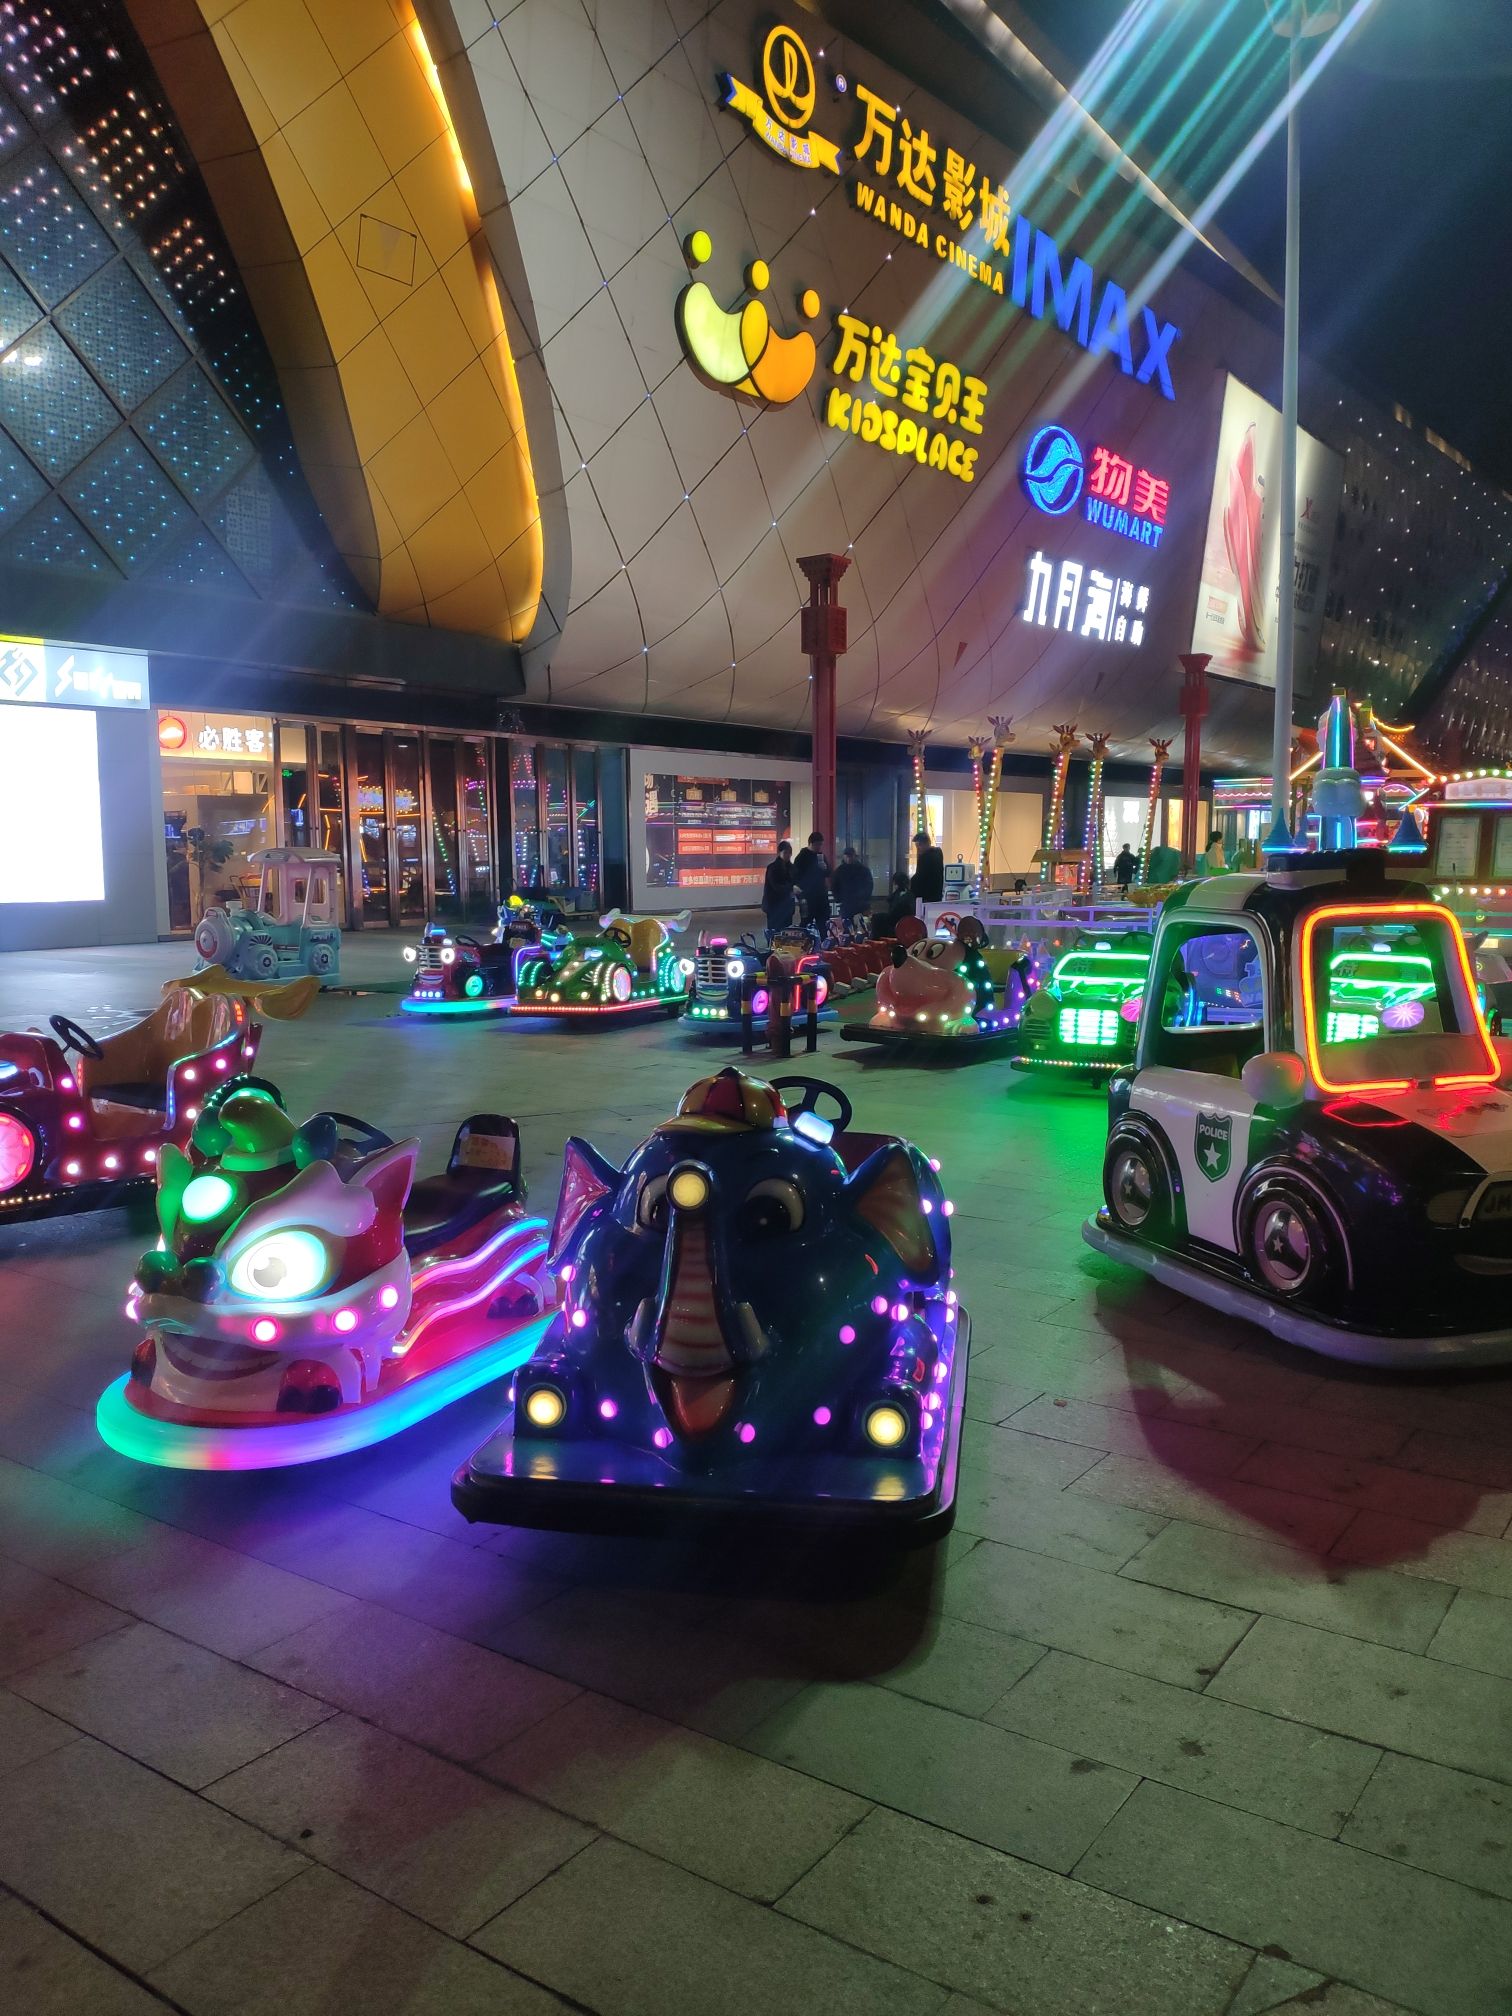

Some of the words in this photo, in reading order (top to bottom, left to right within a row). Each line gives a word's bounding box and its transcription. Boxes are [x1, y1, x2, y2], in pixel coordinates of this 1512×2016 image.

[854, 84, 1010, 257] 万达影城
[857, 182, 929, 249] WANDA
[935, 234, 1004, 295] CINEMA
[1012, 214, 1178, 401] IMAX
[833, 314, 988, 435] 万达宝贝王
[827, 387, 979, 483] KIDSPLACE
[1087, 496, 1164, 549] WUMART
[1090, 447, 1170, 525] 物美
[199, 725, 273, 753] 必胜客
[1199, 1123, 1229, 1141] POLICE
